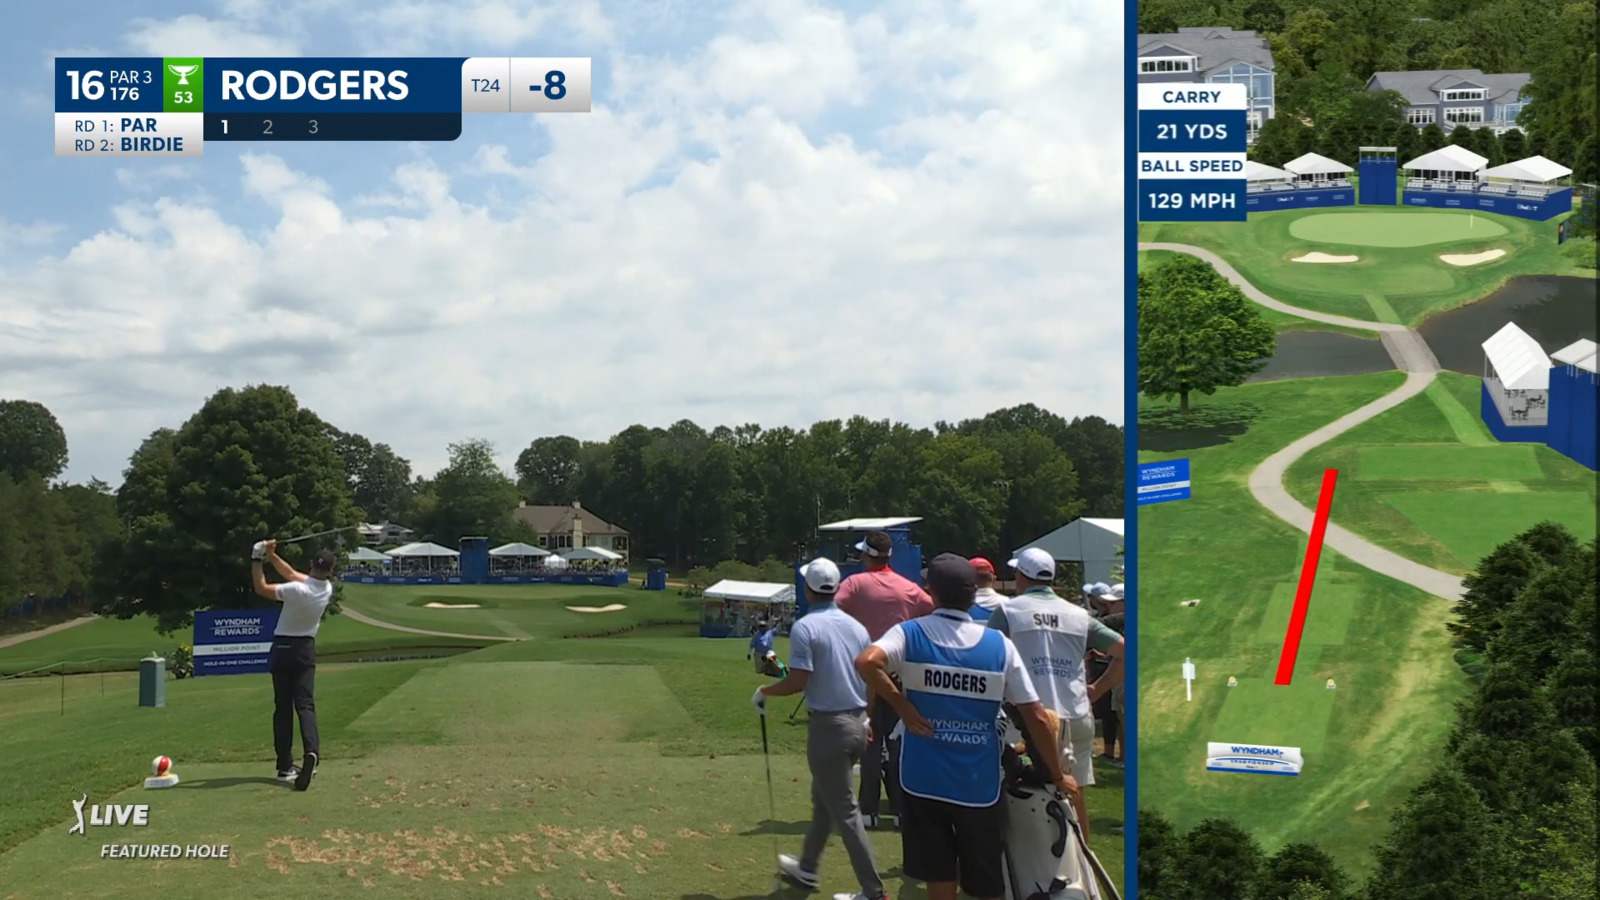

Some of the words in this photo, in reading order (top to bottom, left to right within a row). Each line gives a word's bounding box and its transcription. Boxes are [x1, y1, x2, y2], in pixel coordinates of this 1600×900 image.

[1033, 613, 1059, 628] SUH
[924, 669, 987, 694] RODGERS
[932, 732, 988, 745] EWARDS
[1231, 746, 1280, 756] WYNDHAM
